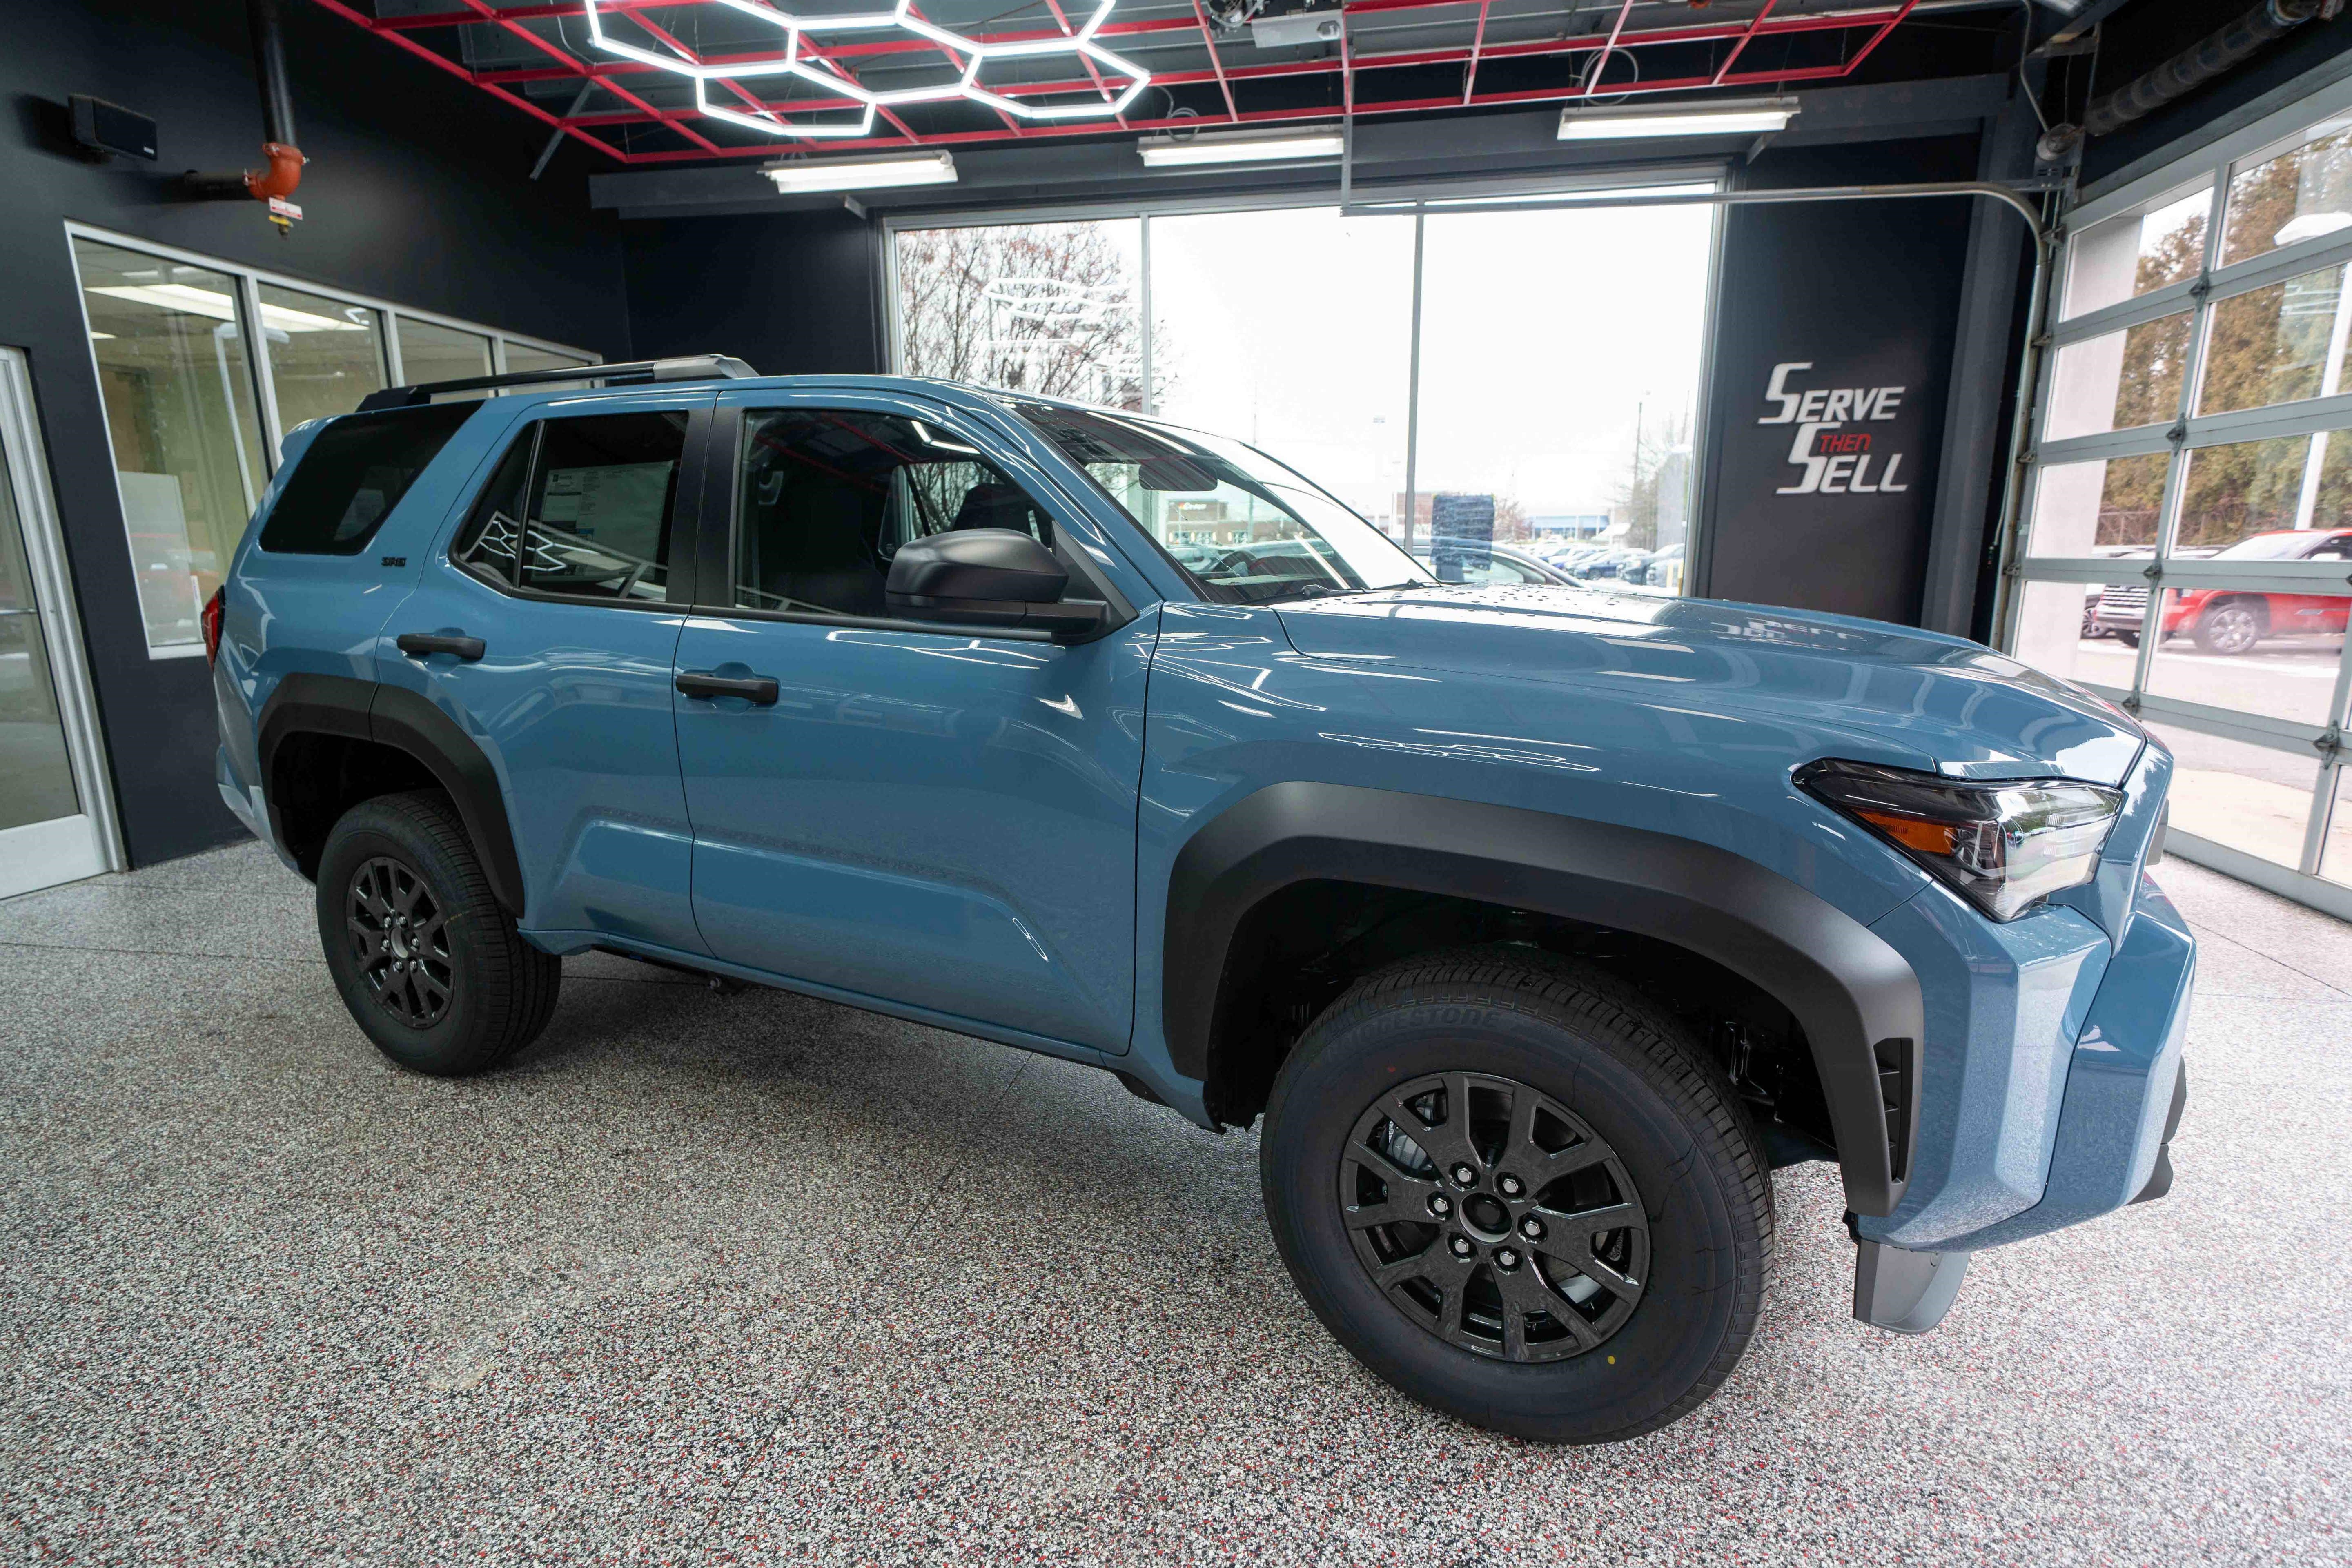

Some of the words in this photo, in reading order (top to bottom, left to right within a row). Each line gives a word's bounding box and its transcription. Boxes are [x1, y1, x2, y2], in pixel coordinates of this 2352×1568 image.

[1757, 362, 1906, 424] SERVE
[1775, 421, 1908, 494] SELL
[1820, 433, 1872, 453] THEN
